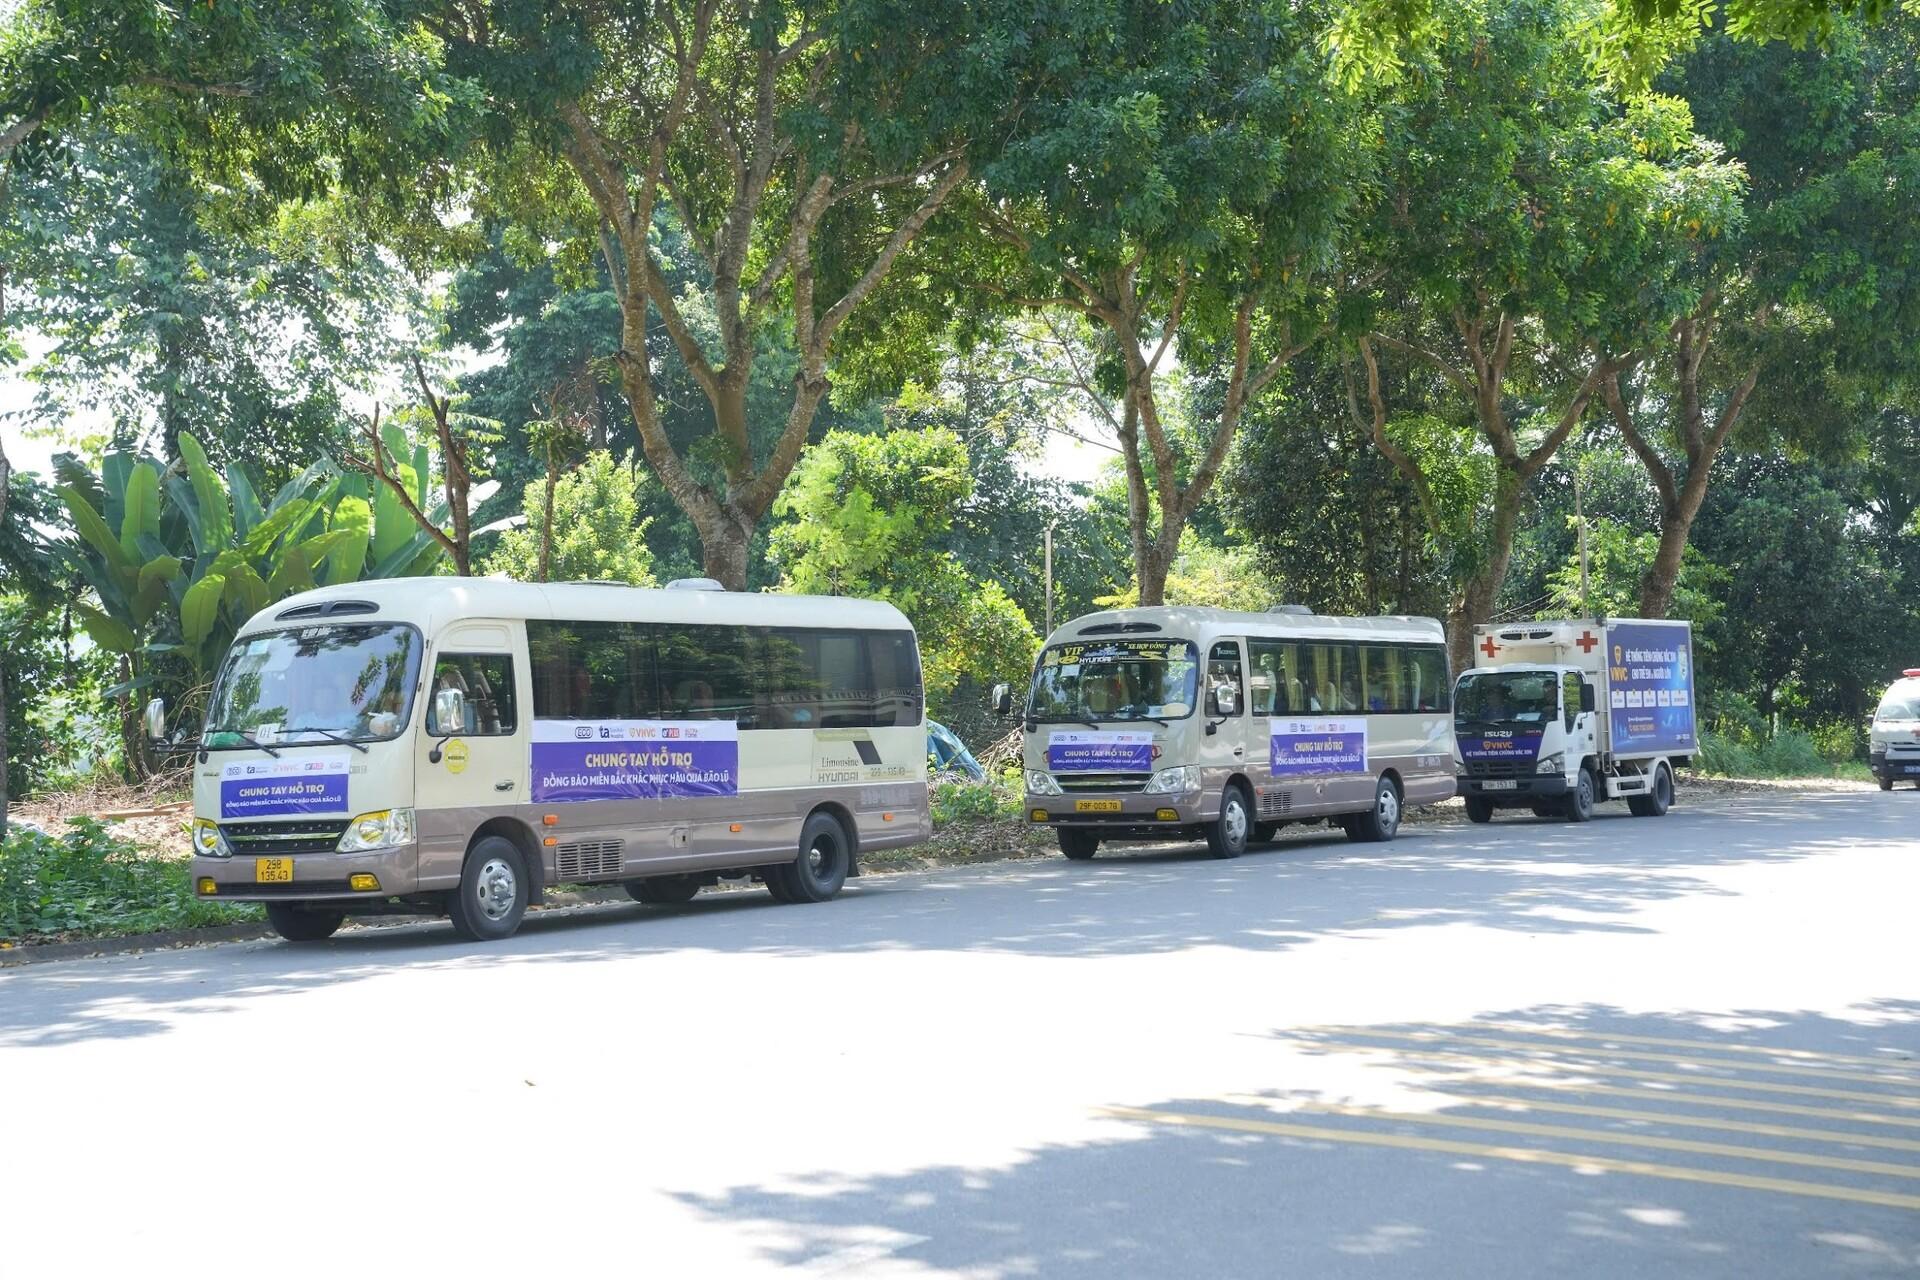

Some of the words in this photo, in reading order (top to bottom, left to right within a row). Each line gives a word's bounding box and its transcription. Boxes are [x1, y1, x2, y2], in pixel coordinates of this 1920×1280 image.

[1064, 646, 1084, 656] VIP
[1079, 656, 1111, 664] HYUNDAI
[1610, 667, 1628, 681] VNVC
[577, 728, 591, 737] ECO
[599, 726, 610, 738] ta
[1484, 730, 1513, 738] ISUZU
[1294, 742, 1313, 752] CHUNG
[1314, 742, 1323, 751] TAY
[1332, 741, 1344, 752] TRỢ
[1491, 741, 1513, 749] VNVC
[586, 753, 627, 768] CHUNG
[629, 753, 649, 767] TAY
[652, 746, 668, 766] HỖ
[670, 752, 692, 769] TRỢ
[822, 756, 859, 768] Limousine
[544, 771, 570, 787] ĐỒNG
[571, 773, 588, 786] BÀO
[590, 771, 609, 785] MIỀN
[611, 770, 625, 785] BẮC
[627, 770, 649, 784] KHẮC
[650, 774, 669, 785] PHỤC
[670, 771, 685, 785] HẬU
[686, 770, 703, 783] QUẢ
[704, 770, 720, 782] BÃO
[721, 770, 729, 782] LŨ
[818, 771, 858, 782] HYUNDAI
[239, 787, 269, 797] CHUNG
[271, 786, 287, 795] TAY
[289, 781, 304, 794] HỖ
[306, 784, 325, 795] TRỢ
[266, 860, 281, 869] 29B
[261, 870, 288, 881] 135.43
